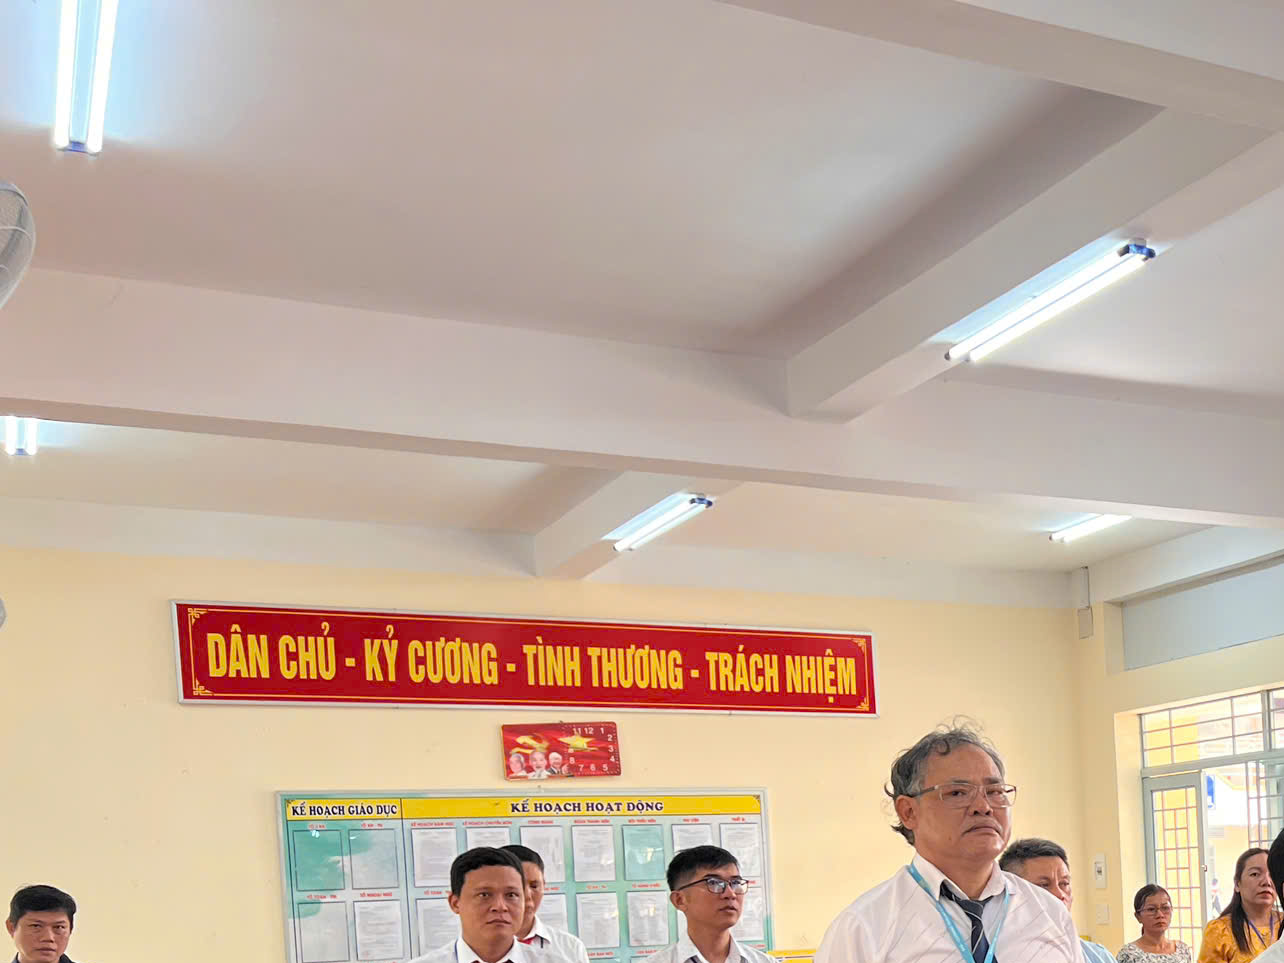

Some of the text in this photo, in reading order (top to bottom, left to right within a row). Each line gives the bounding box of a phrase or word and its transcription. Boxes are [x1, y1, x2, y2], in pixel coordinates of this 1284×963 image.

[207, 623, 270, 679] DÂN
[279, 621, 337, 681] CHỦ
[364, 624, 399, 682] KỶ
[407, 636, 499, 685] CƯƠNG
[522, 636, 582, 687] TÌNH
[587, 644, 684, 690] THƯƠNG
[705, 644, 780, 693] TRÁCH
[785, 648, 857, 704] NHIỆM
[291, 801, 398, 819] KẾ HOẠCH GIÁO DỤC
[510, 798, 664, 816] KẾ HOẠCH HOẠT ĐỘNG
